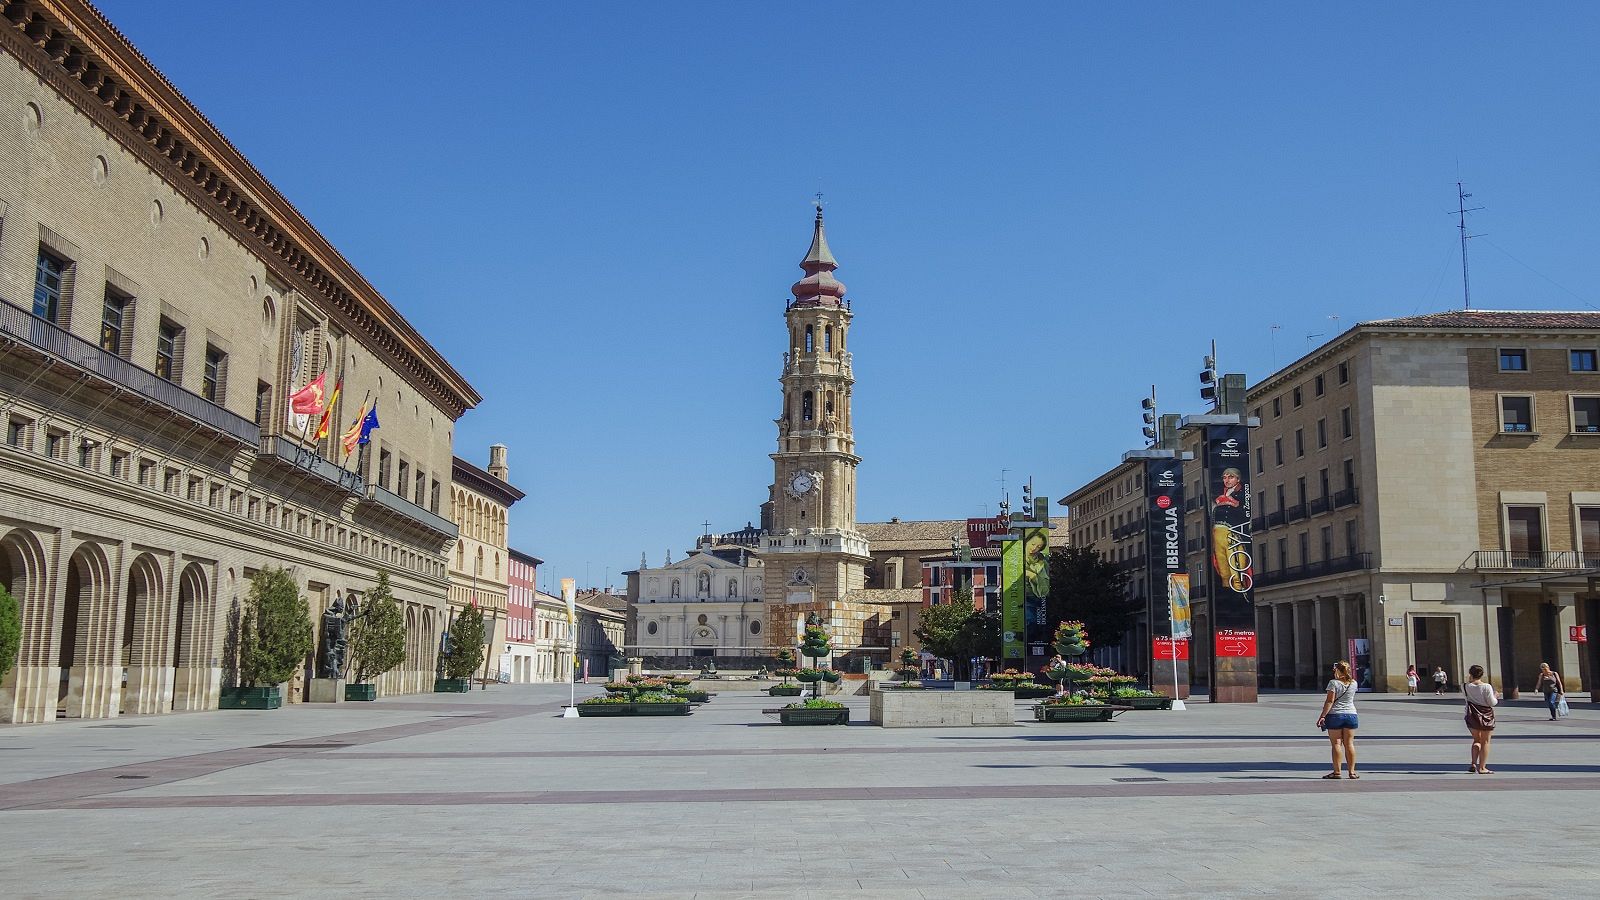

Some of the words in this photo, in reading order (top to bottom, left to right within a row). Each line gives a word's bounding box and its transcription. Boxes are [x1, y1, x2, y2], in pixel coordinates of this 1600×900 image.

[1165, 506, 1179, 569] IBERCAJA
[1228, 521, 1253, 592] GOYA
[1243, 483, 1251, 509] Zaragoza
